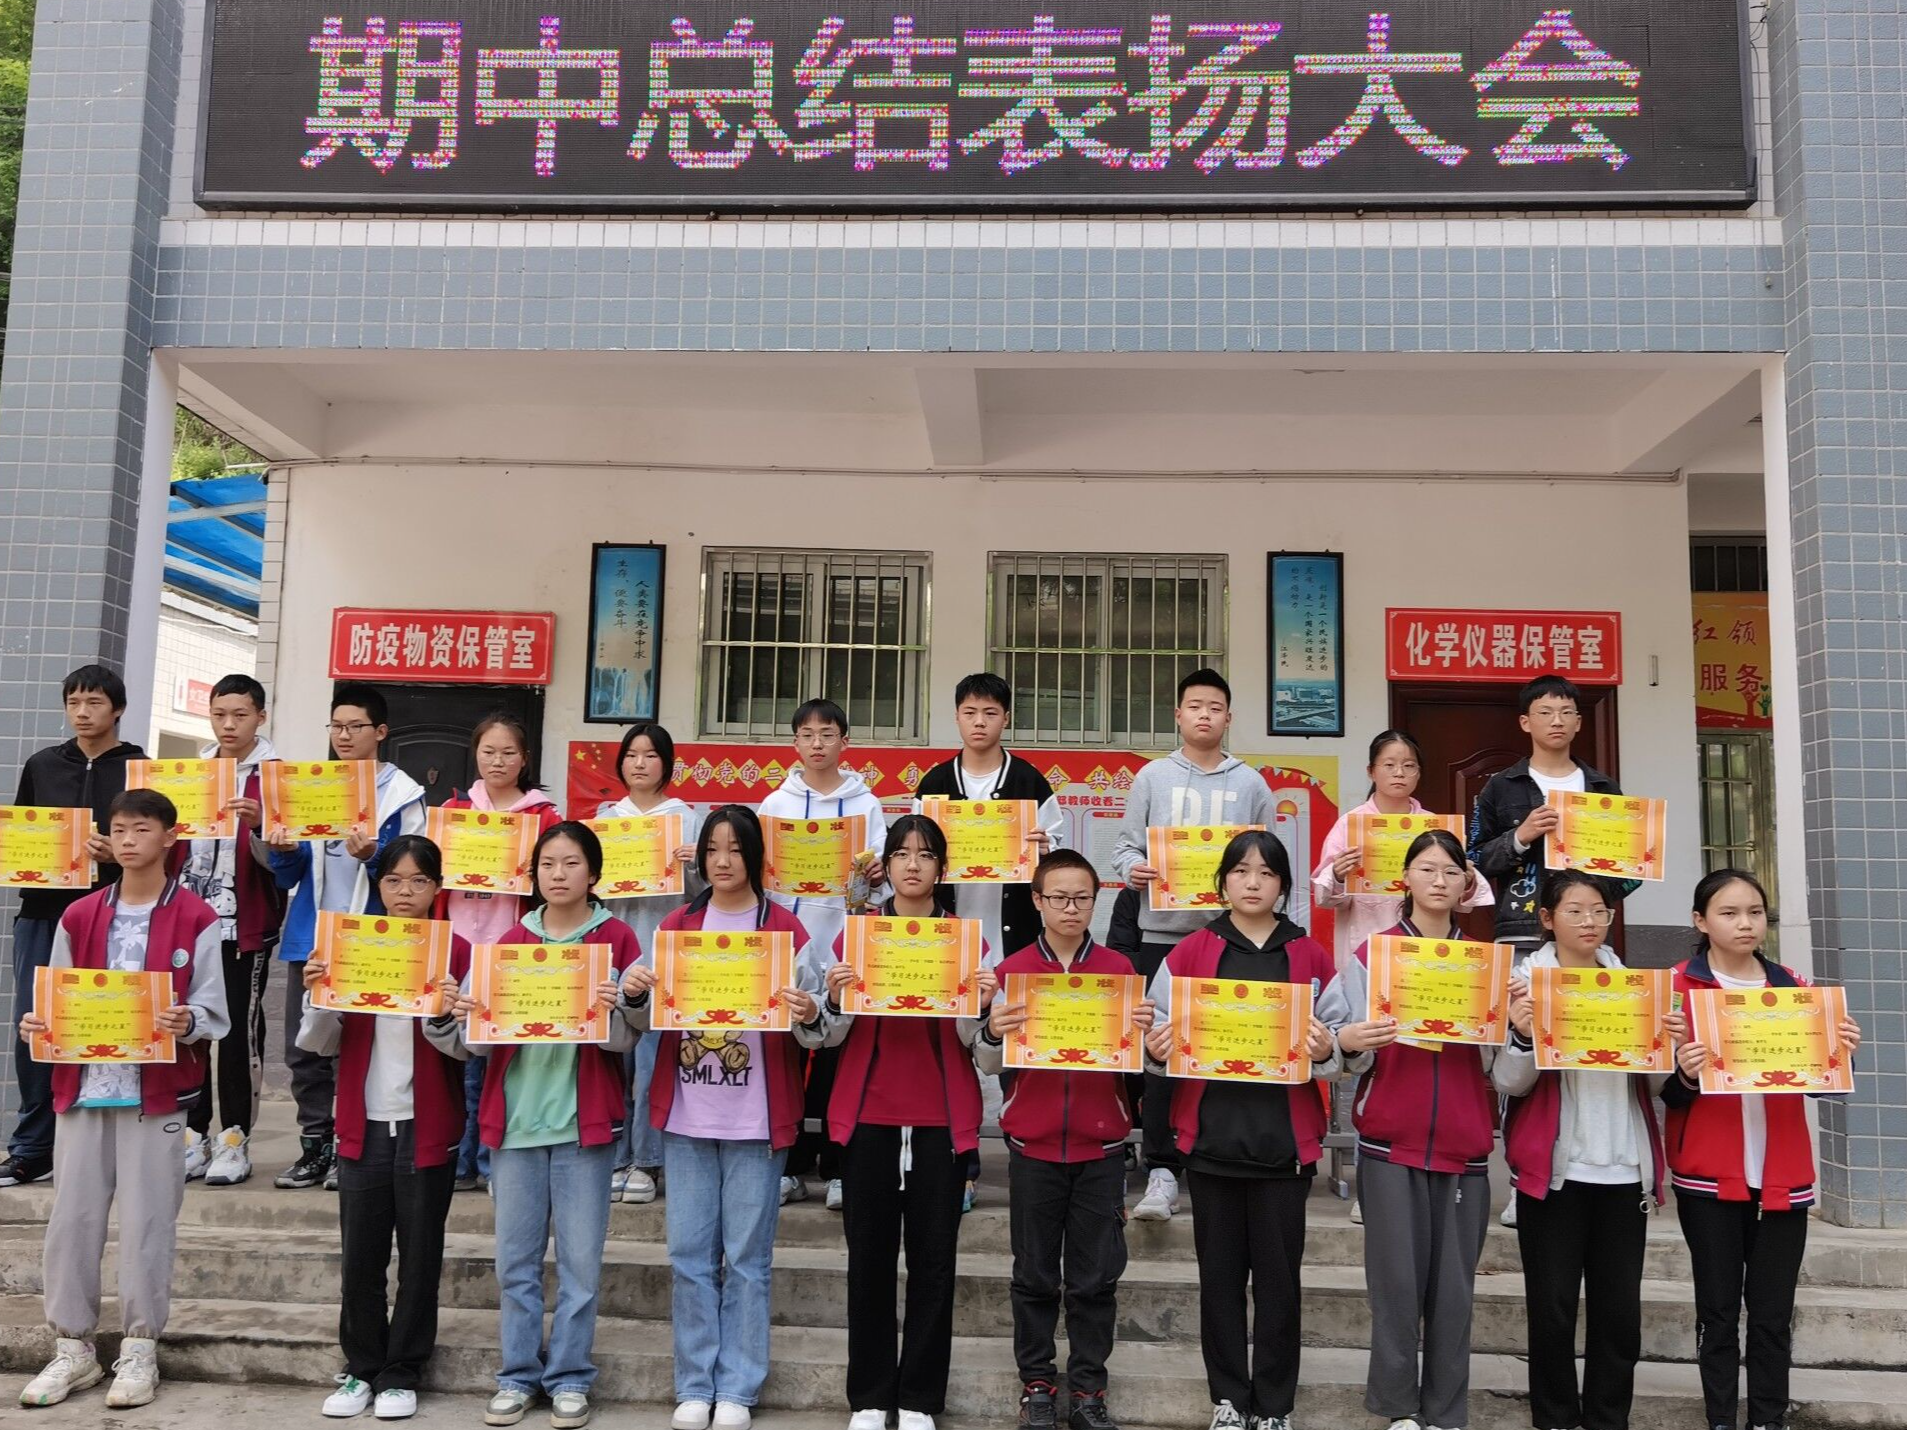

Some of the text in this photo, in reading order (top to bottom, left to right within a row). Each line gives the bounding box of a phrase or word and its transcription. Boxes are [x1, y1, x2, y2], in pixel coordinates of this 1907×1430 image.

[299, 10, 1642, 176] 期中总结表扬大会
[349, 622, 536, 671] 防疫物资保管室
[1405, 622, 1604, 670] 化学仪器保管室
[1693, 618, 1757, 646] 红领
[1701, 663, 1764, 693] 服务
